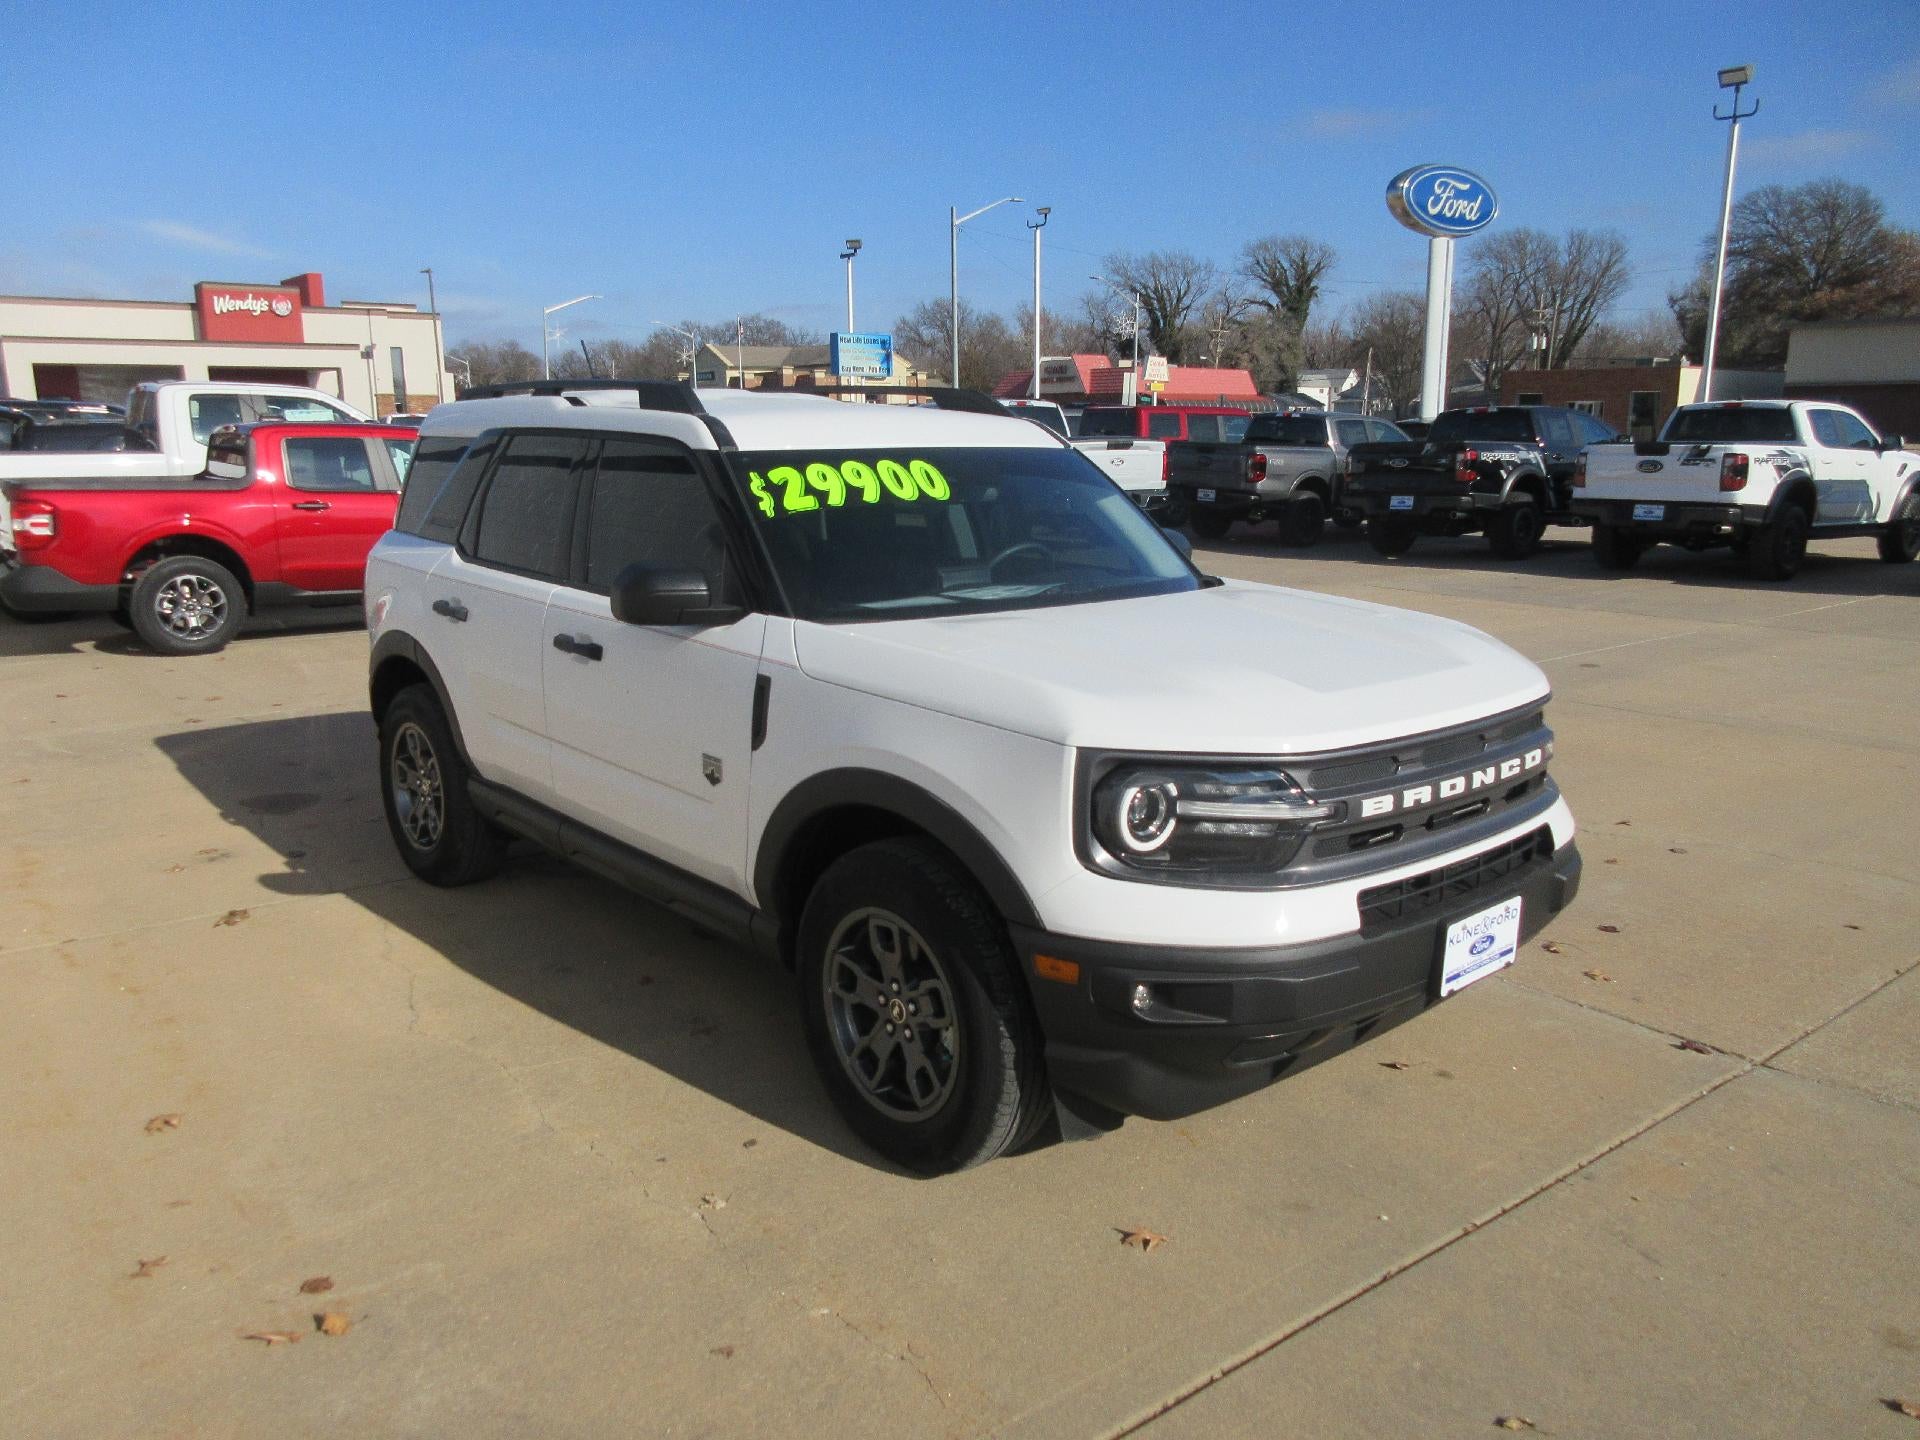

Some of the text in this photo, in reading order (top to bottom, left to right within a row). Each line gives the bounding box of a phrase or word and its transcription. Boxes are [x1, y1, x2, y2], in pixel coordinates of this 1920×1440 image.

[1427, 178, 1482, 221] Ford
[213, 293, 269, 316] Wendy's
[1754, 457, 1790, 465] RAPTOR
[749, 459, 950, 518] $29900
[1361, 749, 1542, 818] BRONCO
[1489, 908, 1518, 928] FORD
